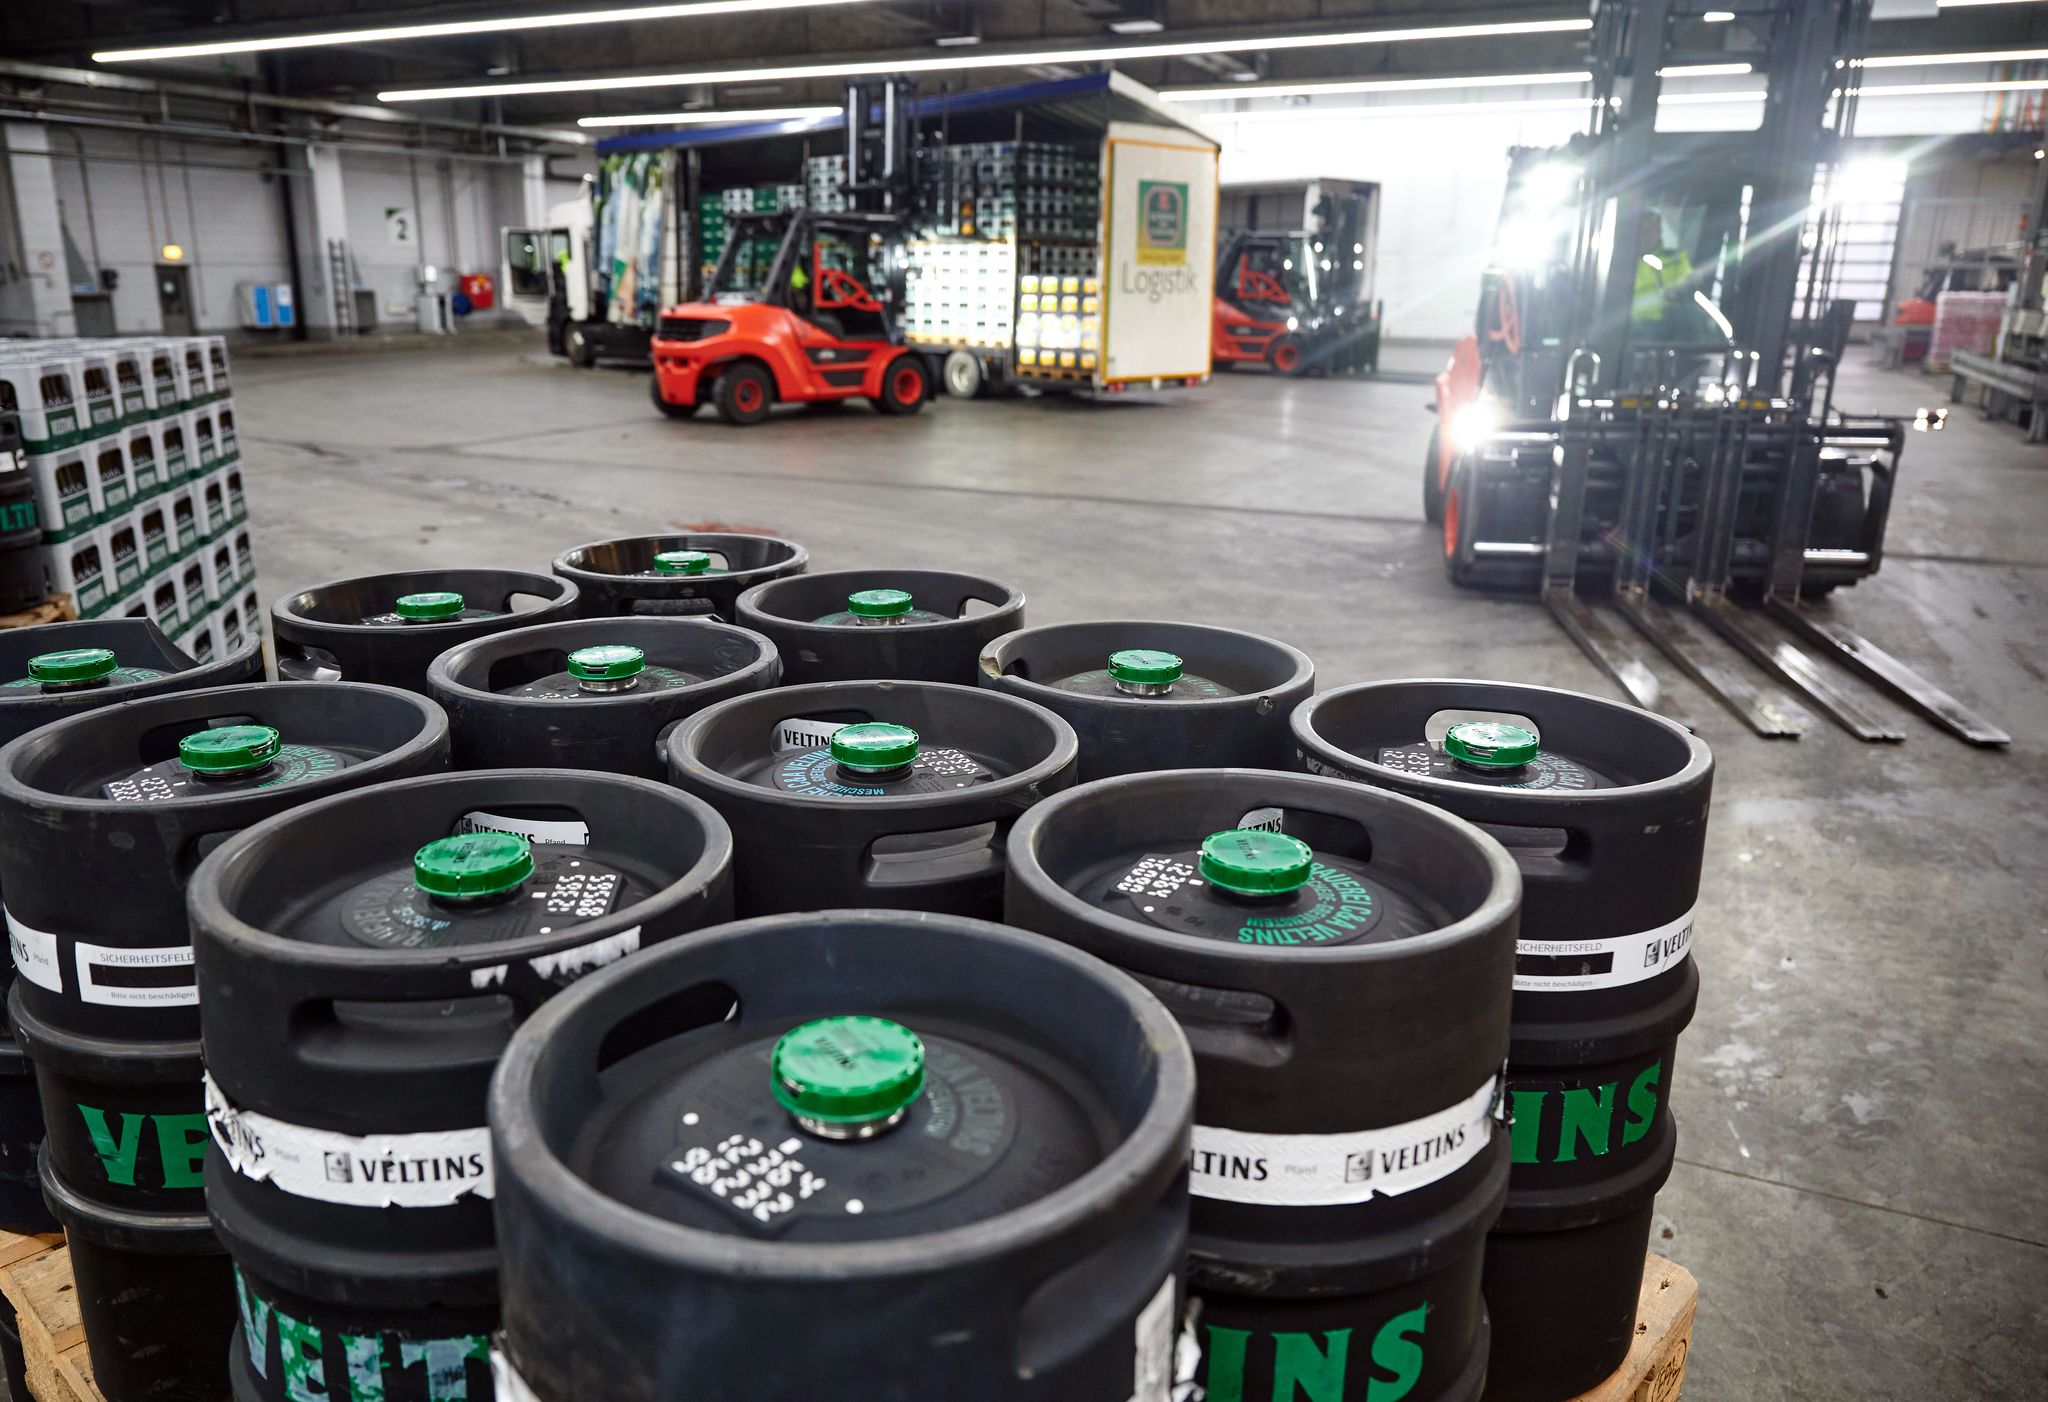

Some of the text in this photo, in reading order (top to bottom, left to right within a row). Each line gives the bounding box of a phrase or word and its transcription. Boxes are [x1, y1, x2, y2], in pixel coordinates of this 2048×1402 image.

[1122, 261, 1198, 303] Logistik
[784, 748, 832, 771] VELTIN
[1237, 922, 1343, 946] VELTINS
[100, 952, 195, 964] SICHERHEITSFELD
[1515, 942, 1603, 954] SICHERHEITSFELD
[111, 991, 195, 1001] Bitte nicht beschädigen
[1381, 1124, 1466, 1174] VELTINS
[359, 1153, 484, 1184] VELTINS
